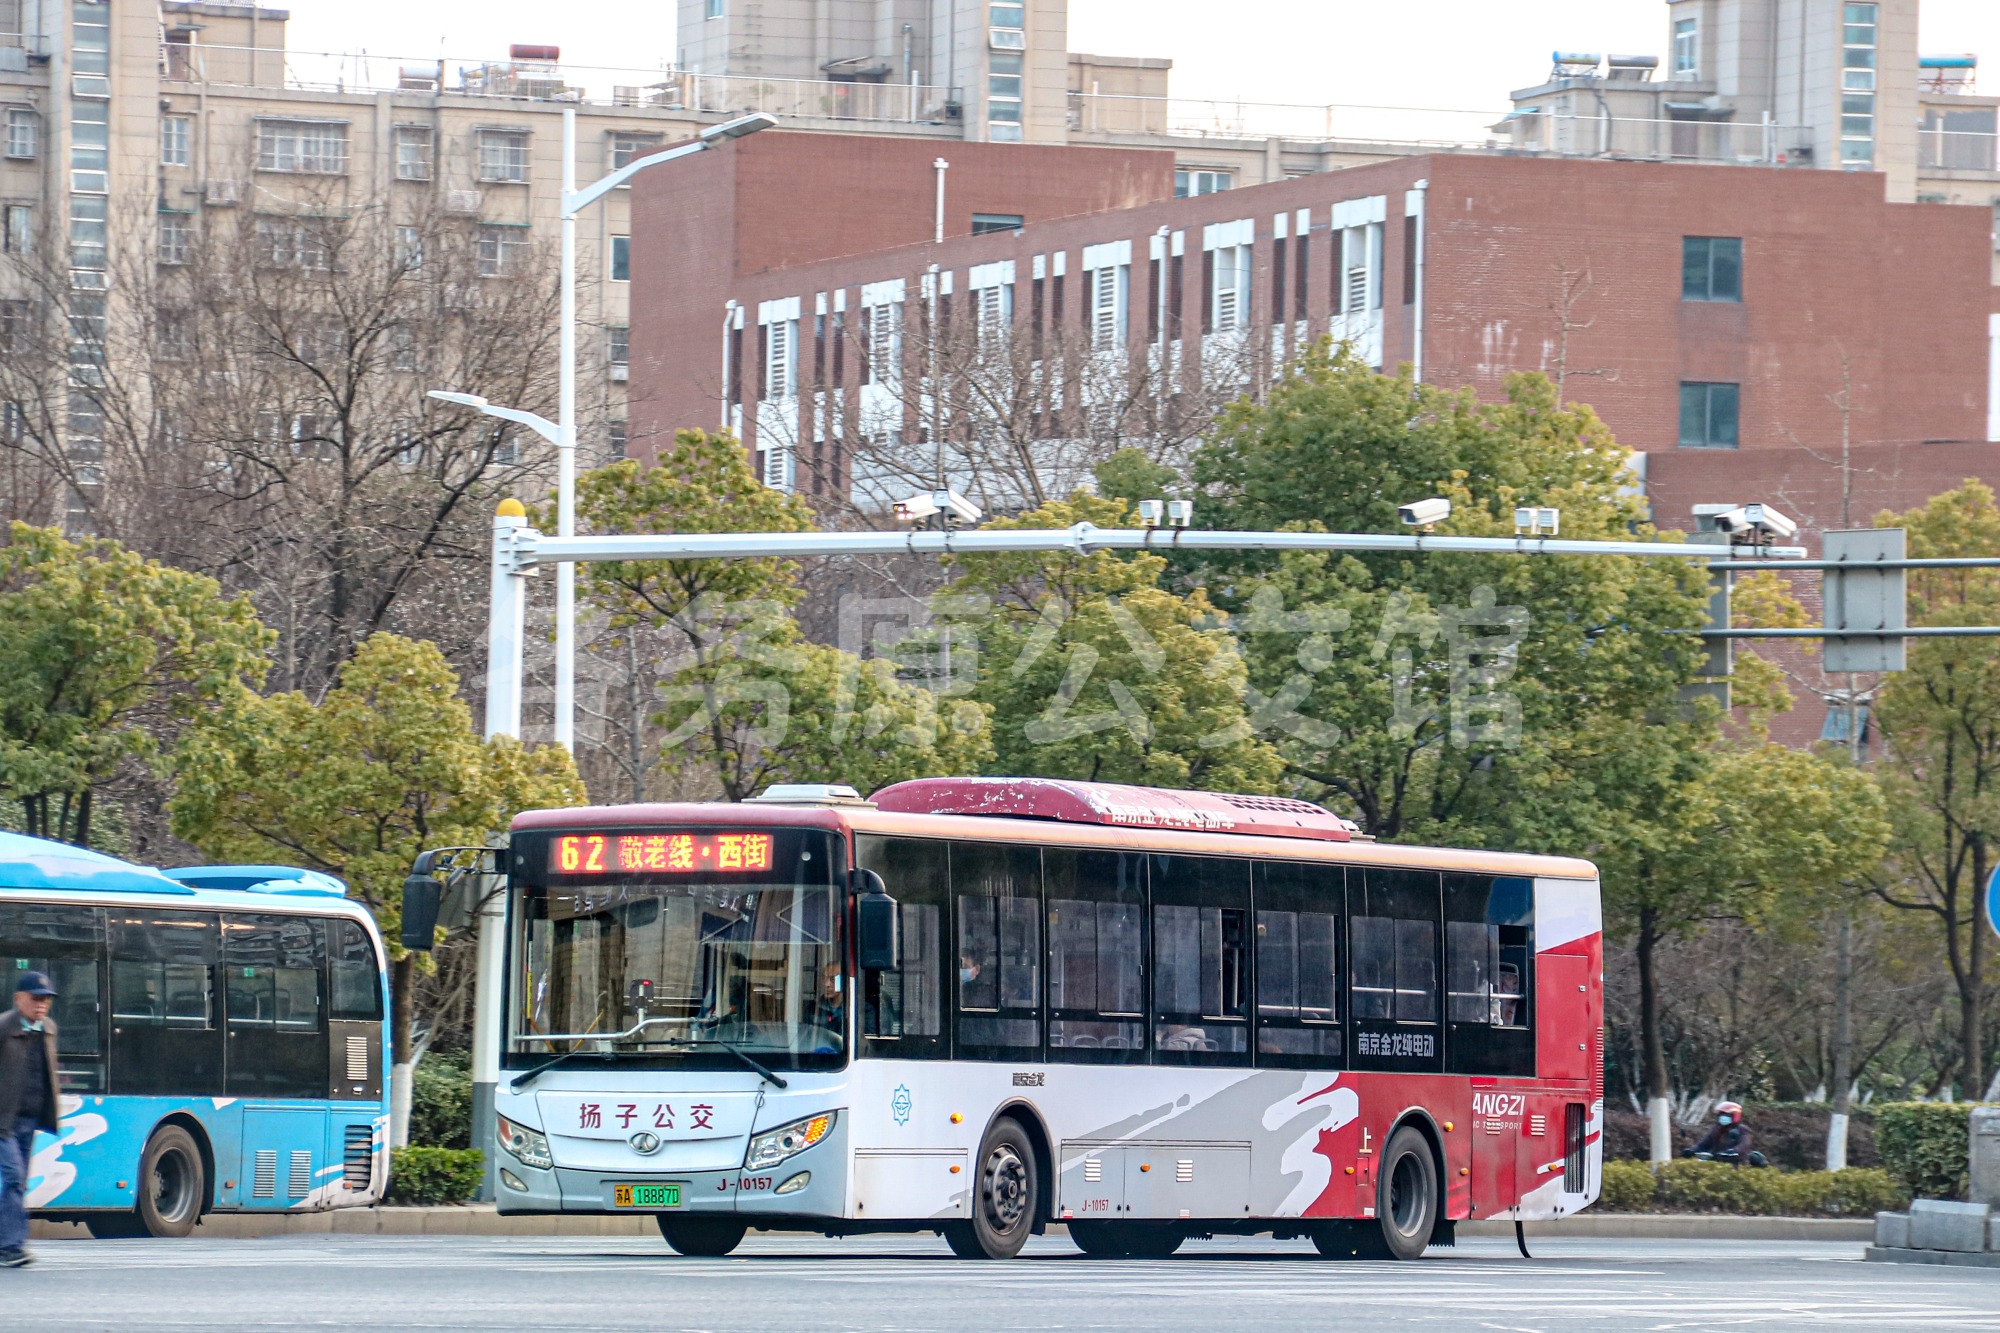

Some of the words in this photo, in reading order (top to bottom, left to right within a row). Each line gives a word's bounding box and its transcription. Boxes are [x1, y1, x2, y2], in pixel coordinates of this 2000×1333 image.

[560, 835, 604, 871] 62
[1358, 1031, 1434, 1057] 南京金龙纯电动
[579, 1103, 714, 1130] 扬子公交
[717, 1177, 772, 1191] J-10157
[1081, 1199, 1109, 1212] J-10157
